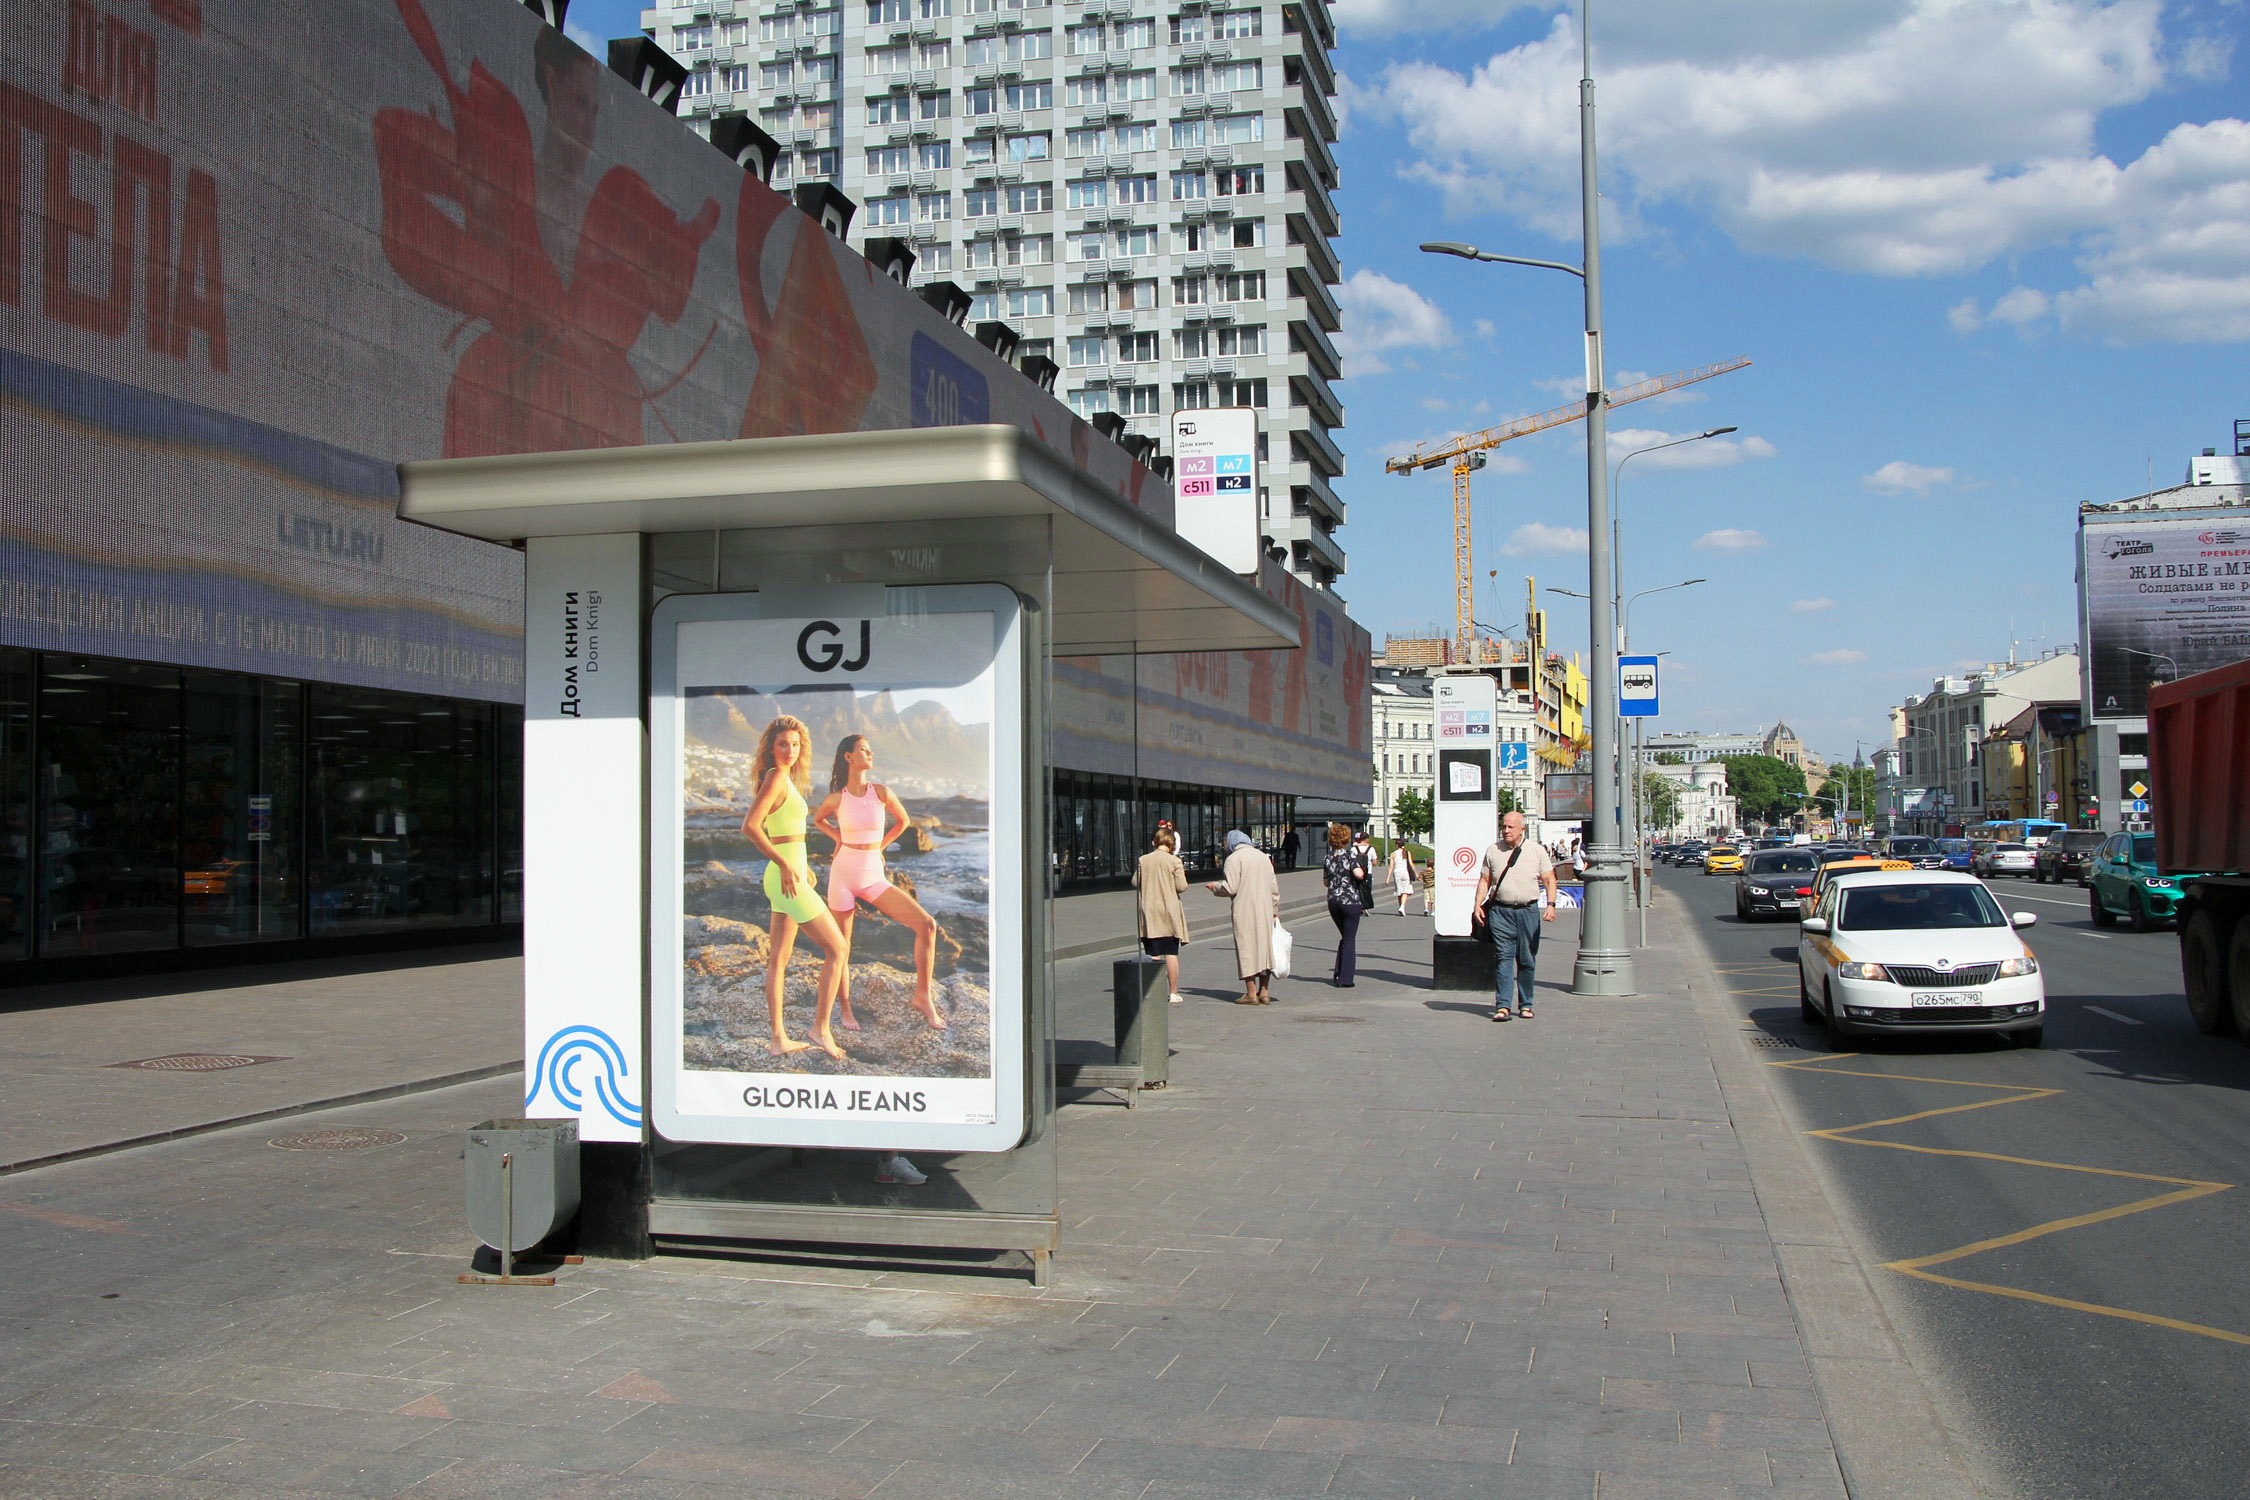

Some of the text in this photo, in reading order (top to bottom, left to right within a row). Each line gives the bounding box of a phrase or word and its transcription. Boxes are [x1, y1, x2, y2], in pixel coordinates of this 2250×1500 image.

[2116, 540, 2141, 548] ТЕАТР
[2129, 563, 2208, 579] ЖИВЫЕ
[2138, 582, 2214, 593] Солдатами
[2220, 581, 2236, 590] не
[2207, 603, 2247, 613] Полина
[586, 590, 602, 673] Dom Knigi
[797, 619, 870, 673] GJ
[560, 665, 581, 718] Дом
[743, 1086, 927, 1113] GLORIA JEANS
